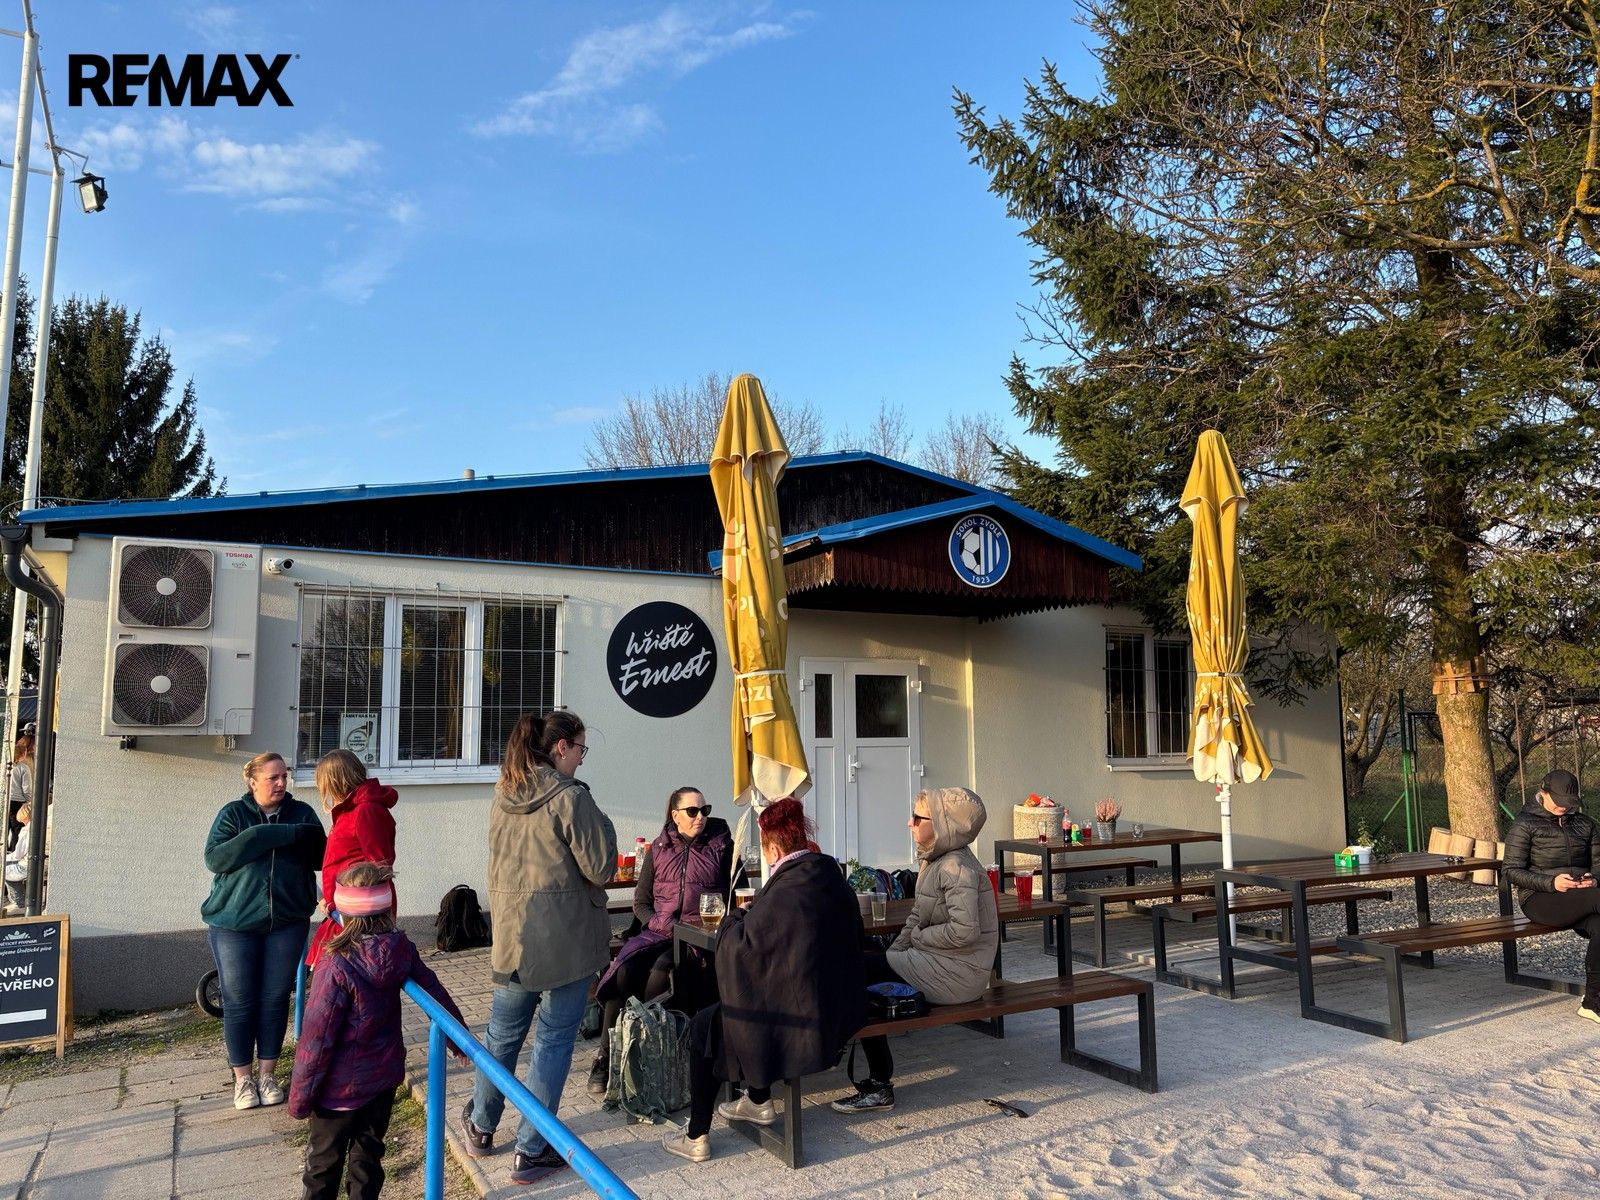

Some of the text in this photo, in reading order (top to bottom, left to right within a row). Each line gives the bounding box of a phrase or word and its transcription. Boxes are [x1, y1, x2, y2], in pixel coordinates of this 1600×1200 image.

[955, 518, 1003, 538] SOKOL ZVOLE
[971, 575, 991, 584] 1923
[625, 622, 695, 657] hřiště
[618, 646, 712, 696] Ernest
